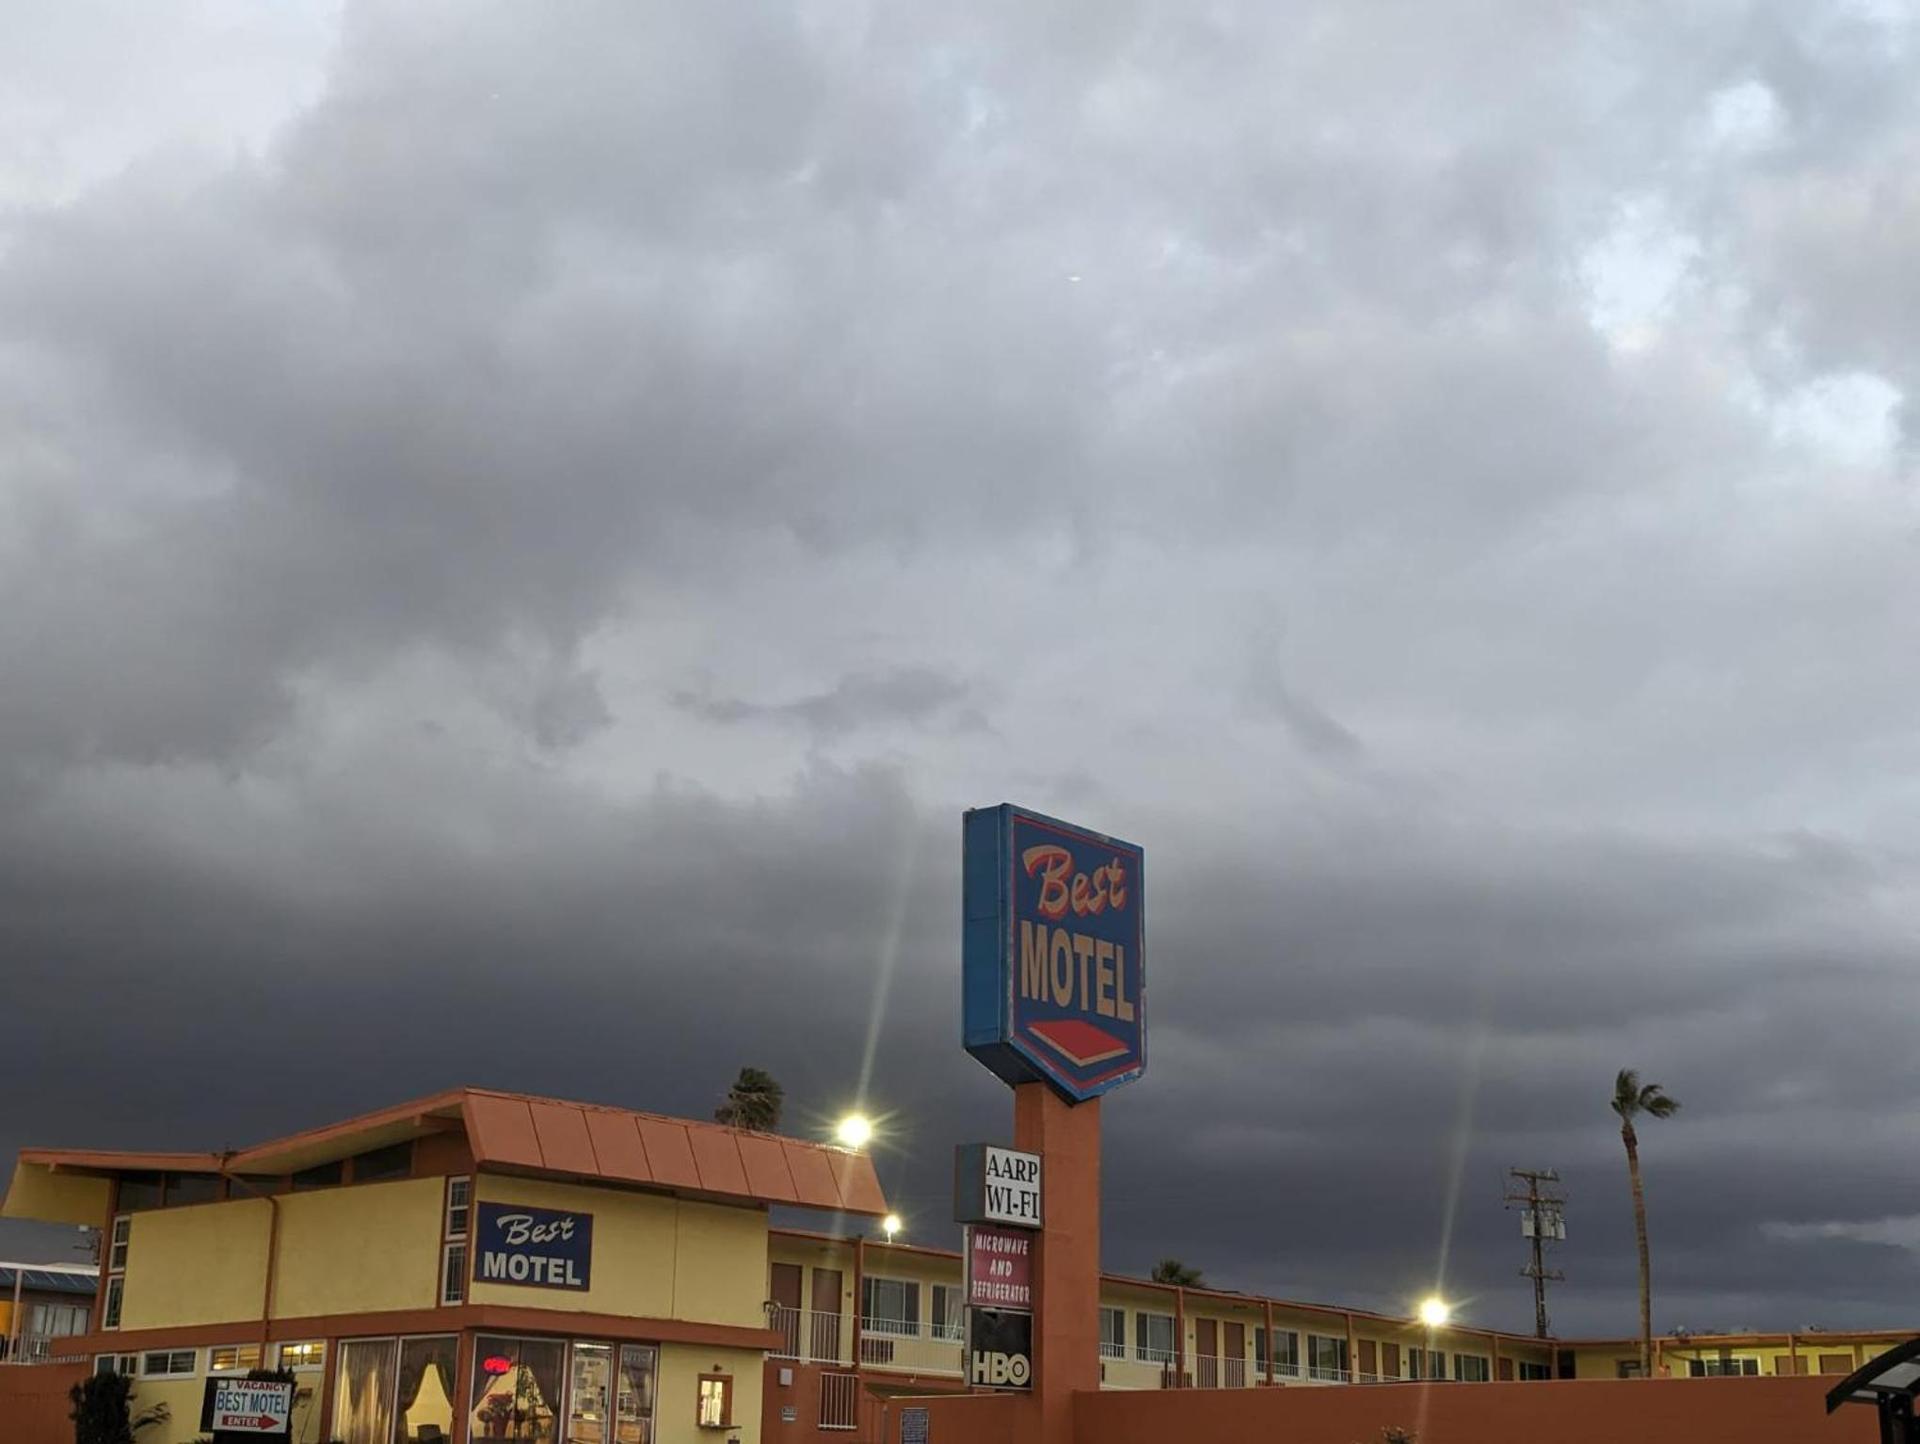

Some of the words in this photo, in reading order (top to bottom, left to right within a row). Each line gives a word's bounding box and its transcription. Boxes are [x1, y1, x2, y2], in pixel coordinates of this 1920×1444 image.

[1022, 845, 1127, 921] Best
[1020, 919, 1134, 1022] MOTEL
[986, 1154, 1038, 1184] AARP
[985, 1184, 1039, 1219] WI-FI
[496, 1214, 575, 1245] Best
[974, 1234, 1028, 1256] MICROWAVE
[483, 1251, 582, 1286] MOTEL
[989, 1258, 1013, 1277] AND
[972, 1279, 1030, 1303] REFRIGERATOR
[972, 1350, 1030, 1386] HBO
[236, 1380, 287, 1392] VACANCY
[216, 1391, 248, 1412] BEST
[249, 1393, 287, 1414] MOTEL
[227, 1415, 259, 1427] ENTER
